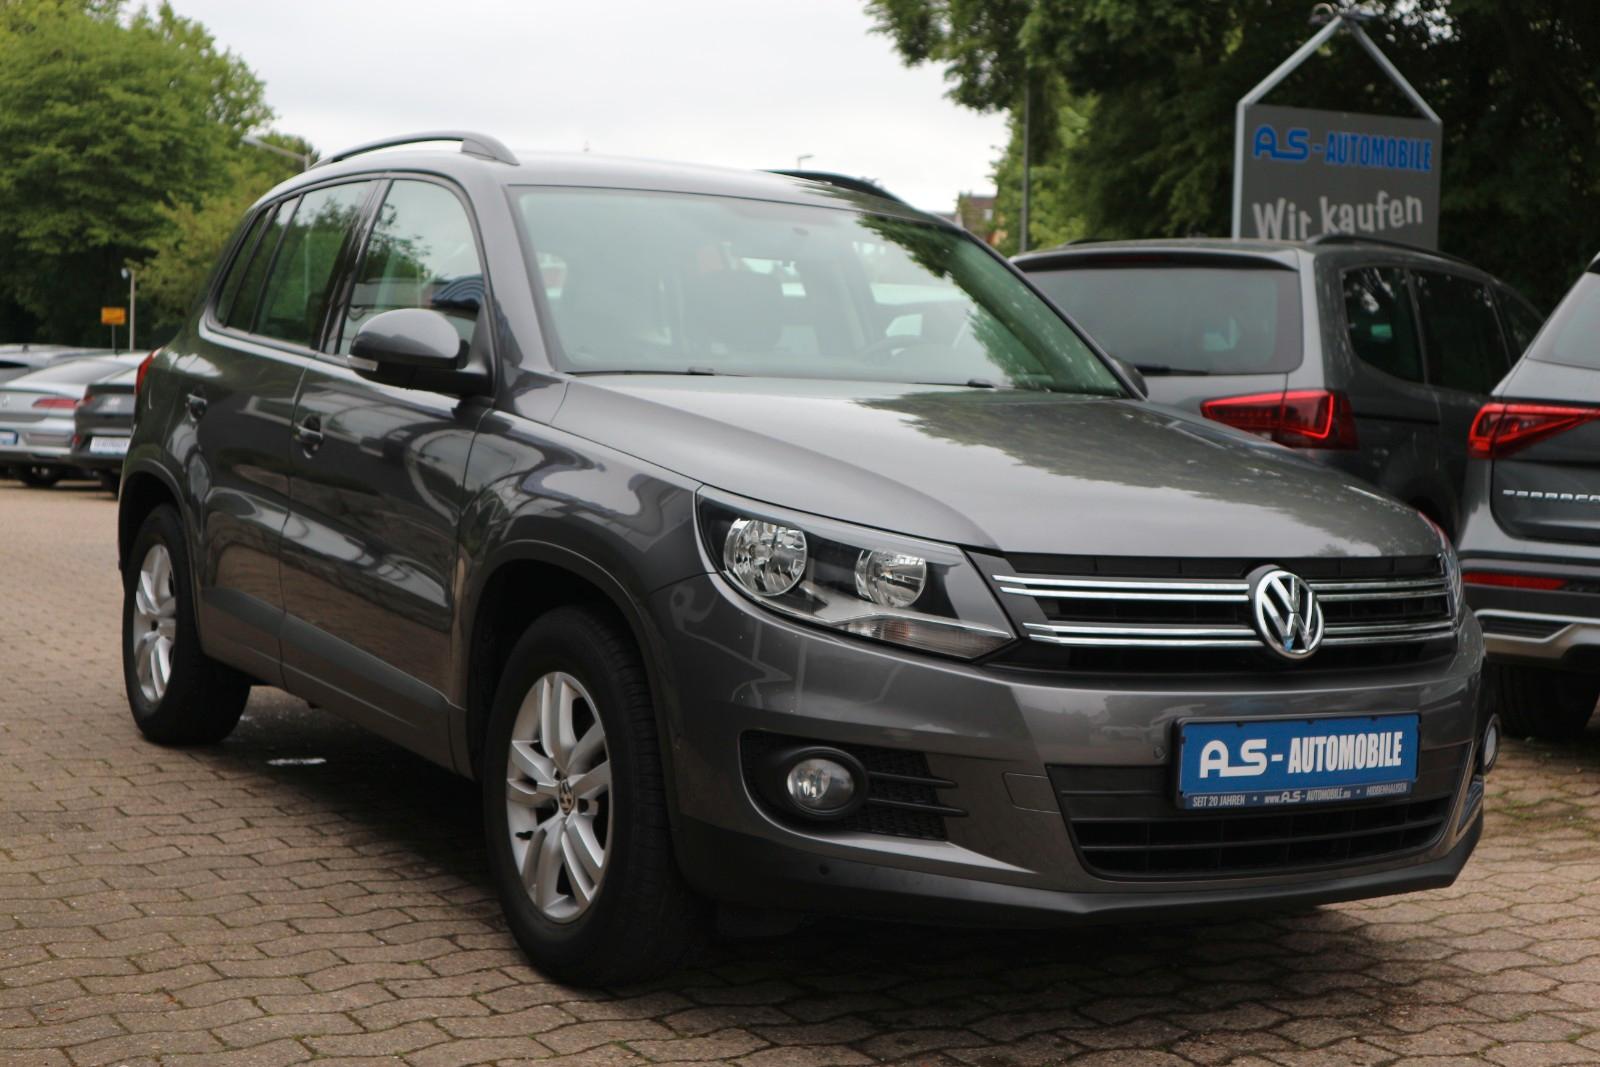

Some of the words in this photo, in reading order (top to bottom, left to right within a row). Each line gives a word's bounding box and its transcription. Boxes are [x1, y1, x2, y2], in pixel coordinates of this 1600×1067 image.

[1253, 198, 1312, 240] Wir
[1319, 190, 1423, 235] kaufen
[1192, 796, 1207, 808] SEIT
[1208, 795, 1218, 806] 20
[1219, 794, 1246, 806] JAHREN
